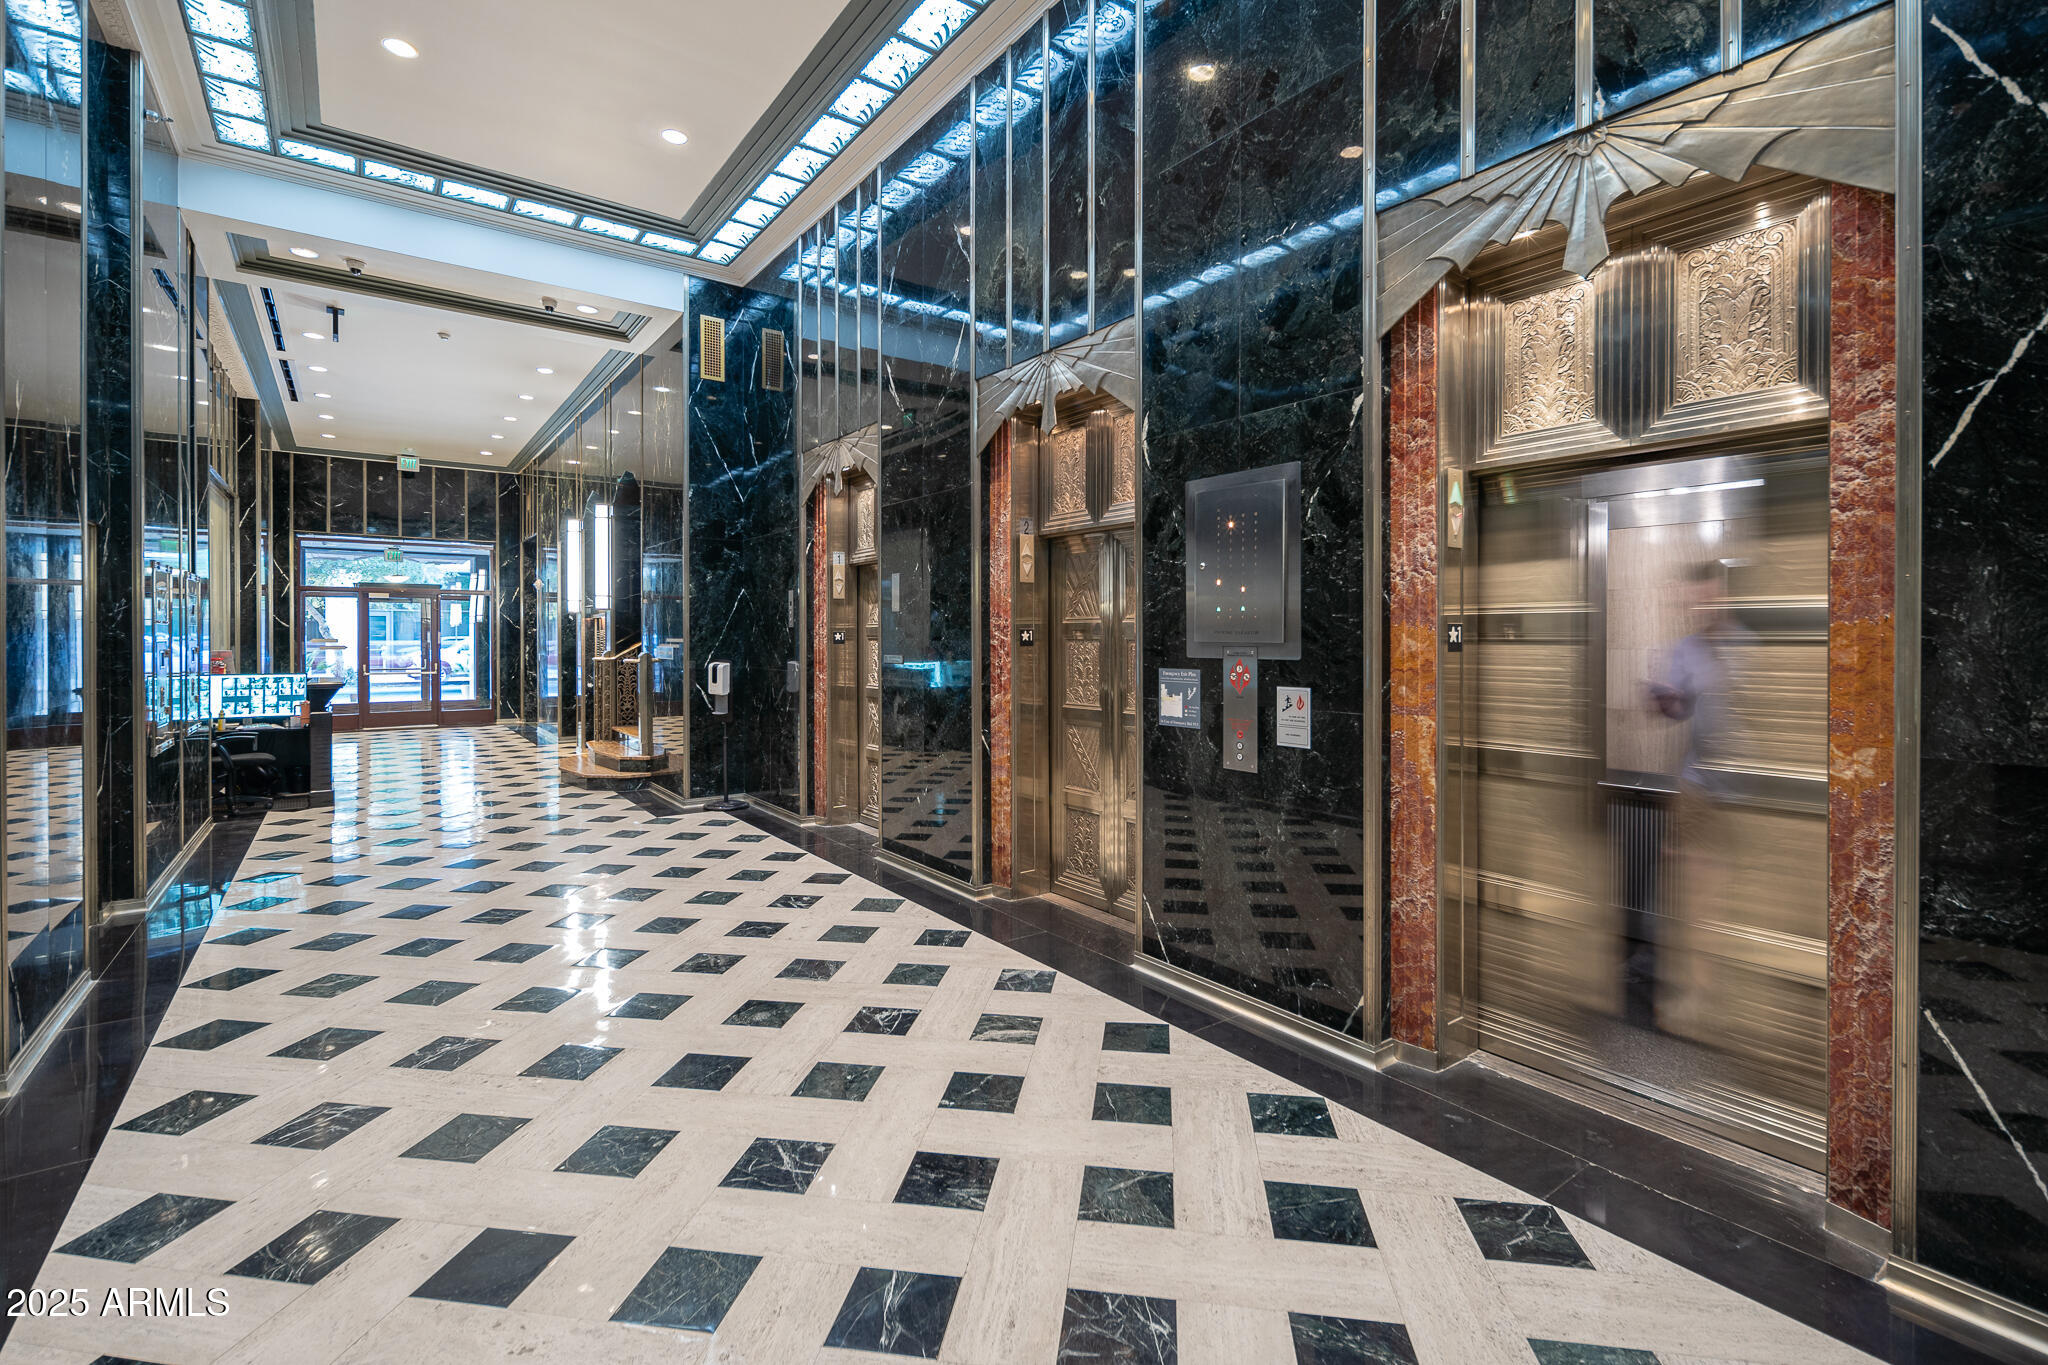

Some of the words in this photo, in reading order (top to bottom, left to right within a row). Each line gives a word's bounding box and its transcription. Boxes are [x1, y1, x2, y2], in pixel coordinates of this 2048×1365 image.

[400, 457, 417, 469] EXIT
[1023, 520, 1030, 534] 2
[387, 551, 402, 560] EXIT
